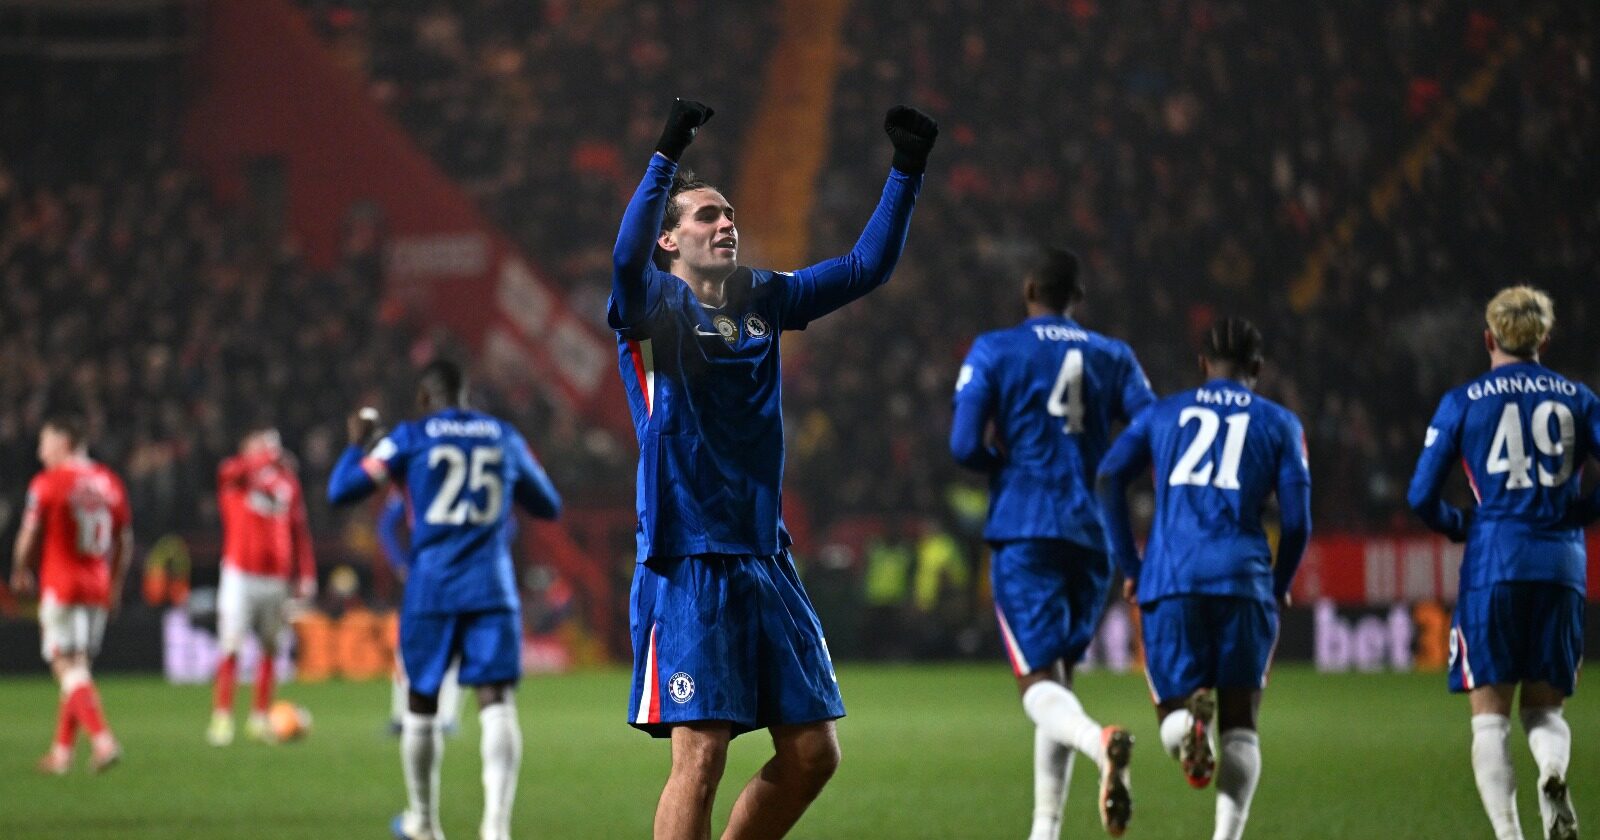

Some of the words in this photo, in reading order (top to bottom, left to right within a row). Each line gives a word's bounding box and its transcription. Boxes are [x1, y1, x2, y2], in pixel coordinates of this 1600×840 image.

[1047, 348, 1083, 434] 4
[1196, 388, 1251, 407] HATO
[1467, 374, 1577, 400] GARNACHO
[425, 445, 503, 526] 25
[1169, 406, 1250, 490] 21
[1487, 400, 1575, 491] 49
[1315, 600, 1452, 672] bet3
